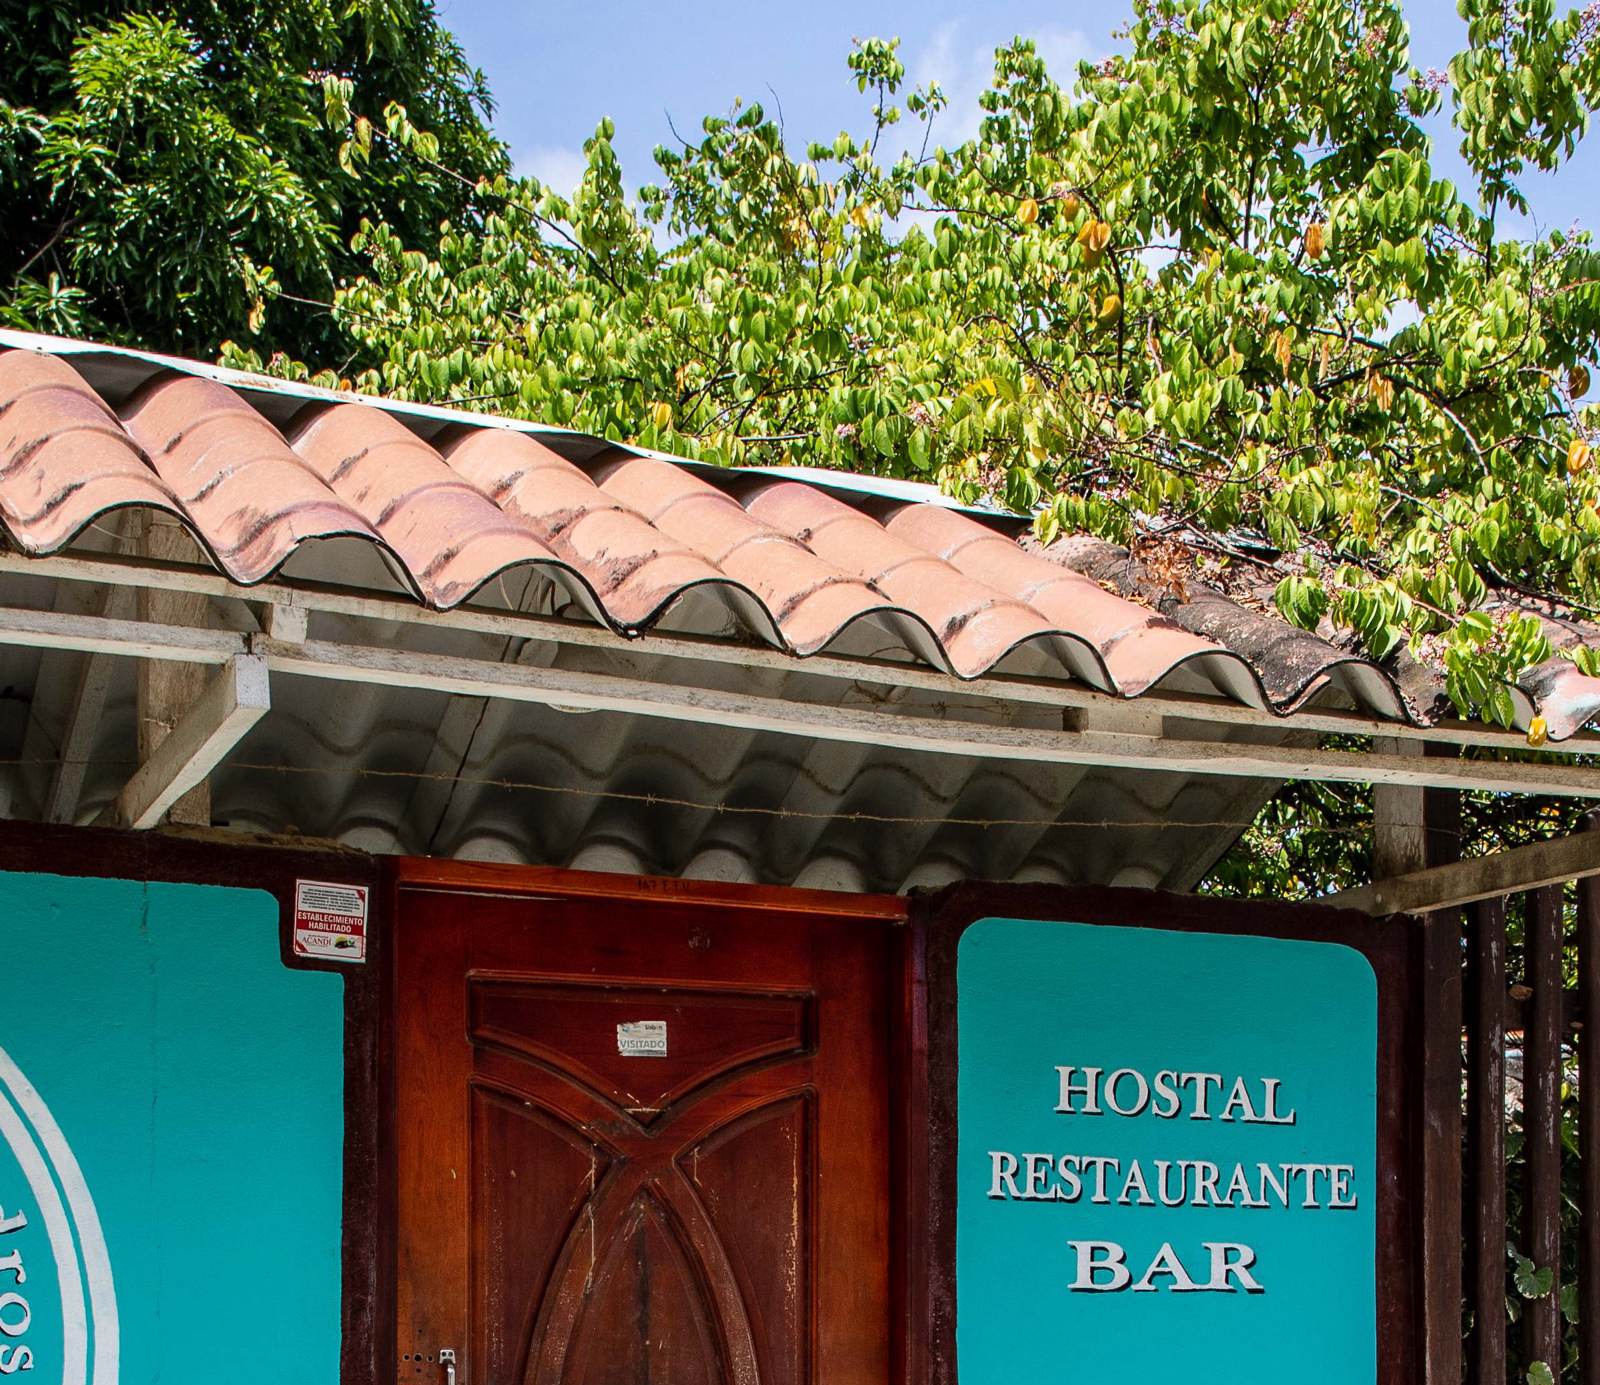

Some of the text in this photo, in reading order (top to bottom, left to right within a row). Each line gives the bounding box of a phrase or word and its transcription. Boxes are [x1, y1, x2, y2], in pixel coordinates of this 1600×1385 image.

[298, 911, 363, 926] ESTABLECIMIENTO
[308, 921, 352, 933] HABILITADO
[620, 1040, 665, 1049] VISITADO
[1054, 1065, 1295, 1124] HOSTAL
[986, 1151, 1358, 1209] RESTAURANTE
[1067, 1240, 1265, 1293] BAR
